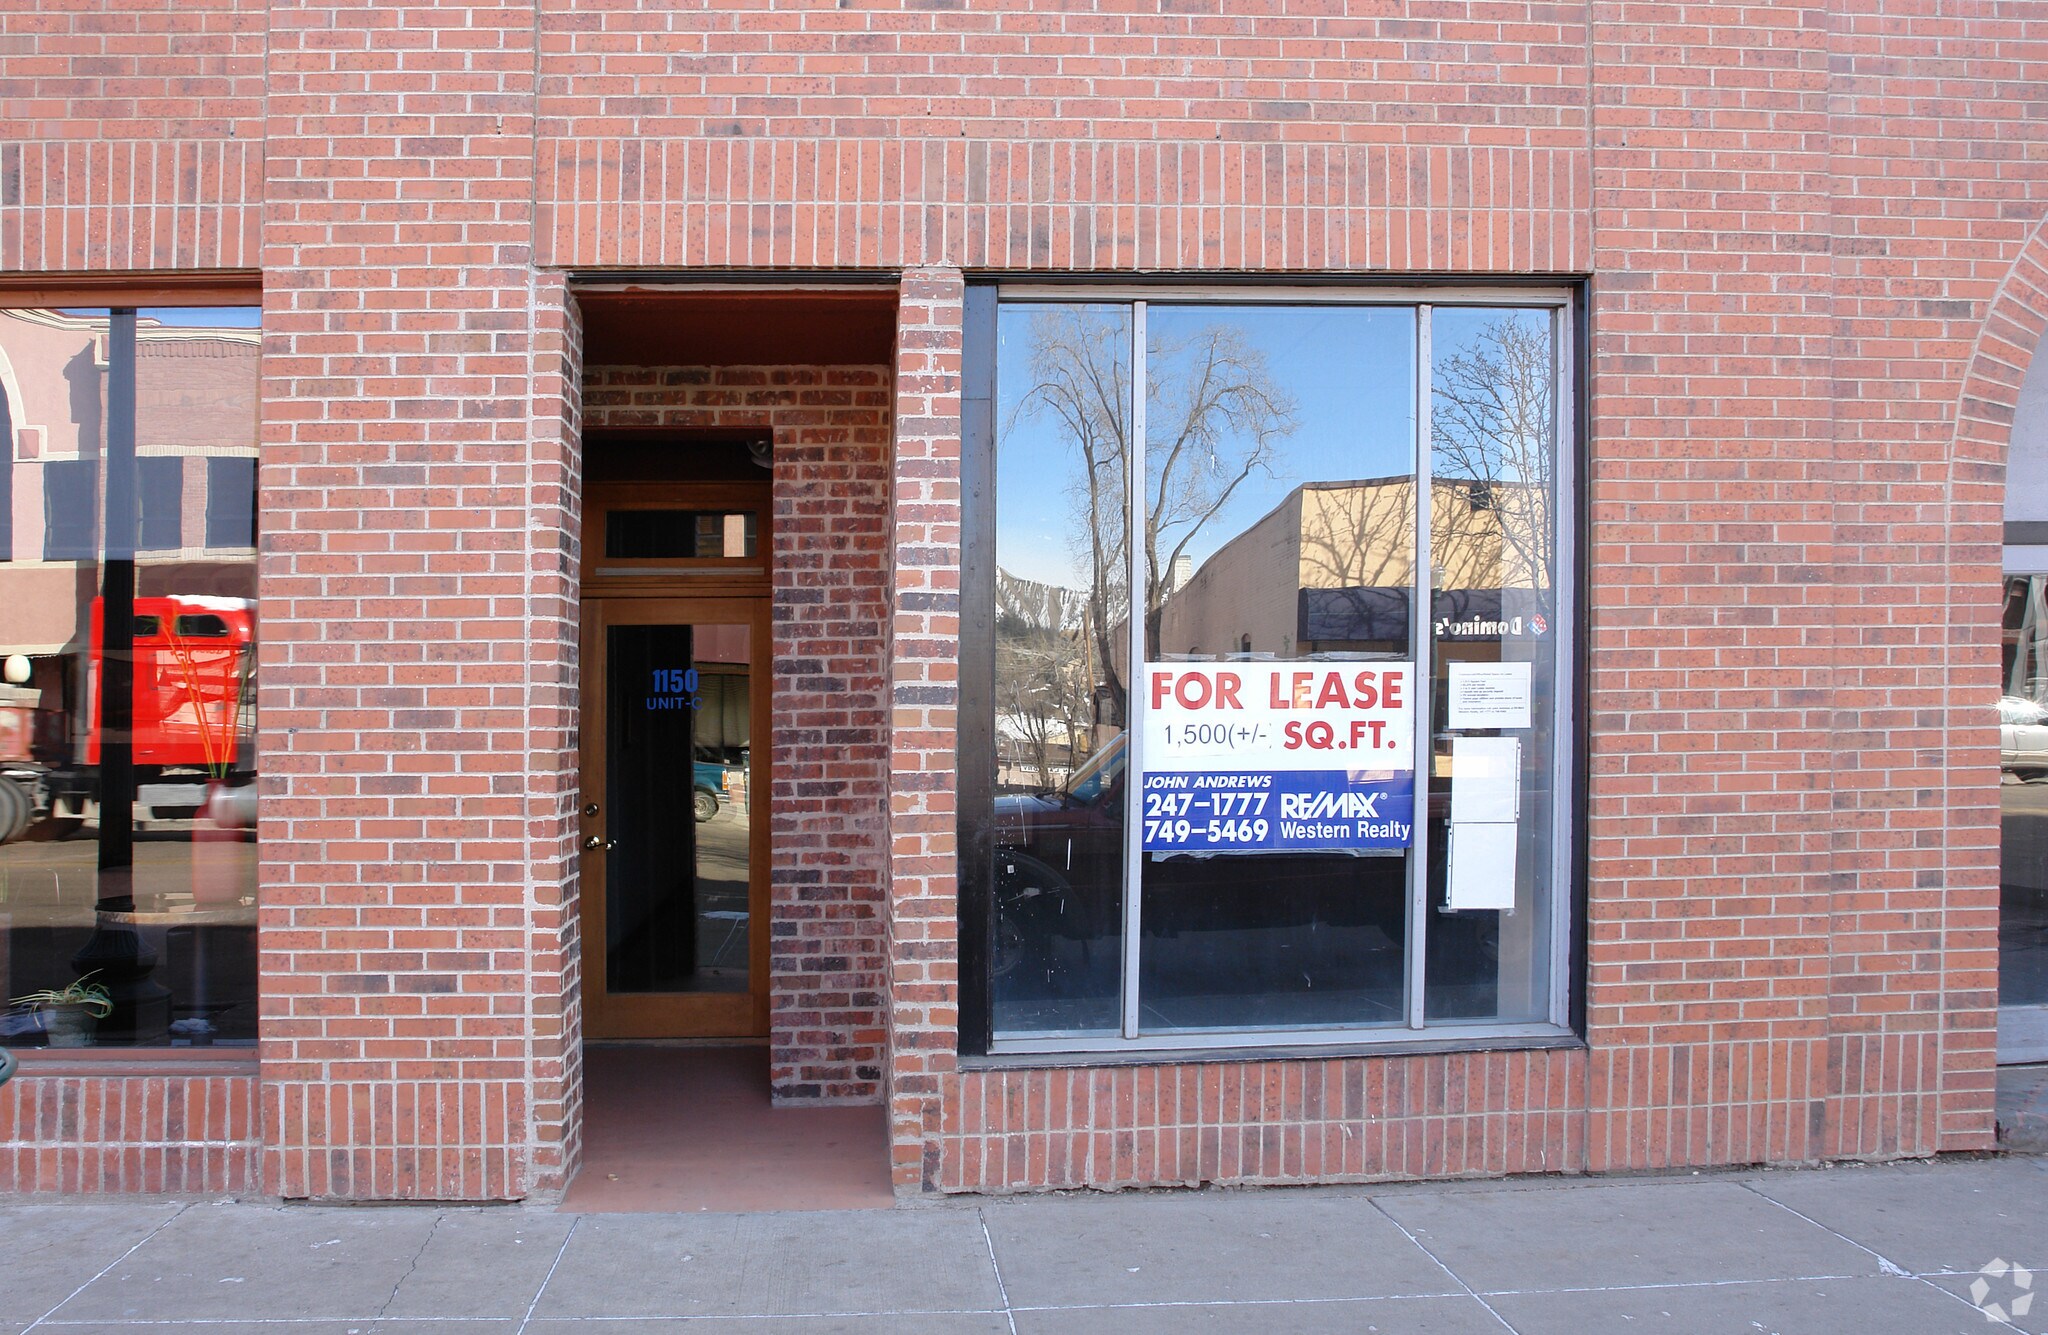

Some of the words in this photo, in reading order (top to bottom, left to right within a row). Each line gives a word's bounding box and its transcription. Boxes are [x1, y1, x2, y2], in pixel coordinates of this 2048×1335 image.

[652, 668, 698, 693] 1150
[1152, 672, 1243, 710] FOR
[1270, 671, 1403, 709] LEASE
[646, 696, 703, 710] UNIT-C
[1283, 721, 1396, 750] SQ.FT.
[1144, 776, 1189, 789] JOHN
[1192, 775, 1272, 788] ANDREWS
[1145, 792, 1270, 817] 247-1777
[1144, 818, 1269, 843] 749-5469
[1280, 821, 1350, 839] Western
[1357, 820, 1411, 841] Realty
